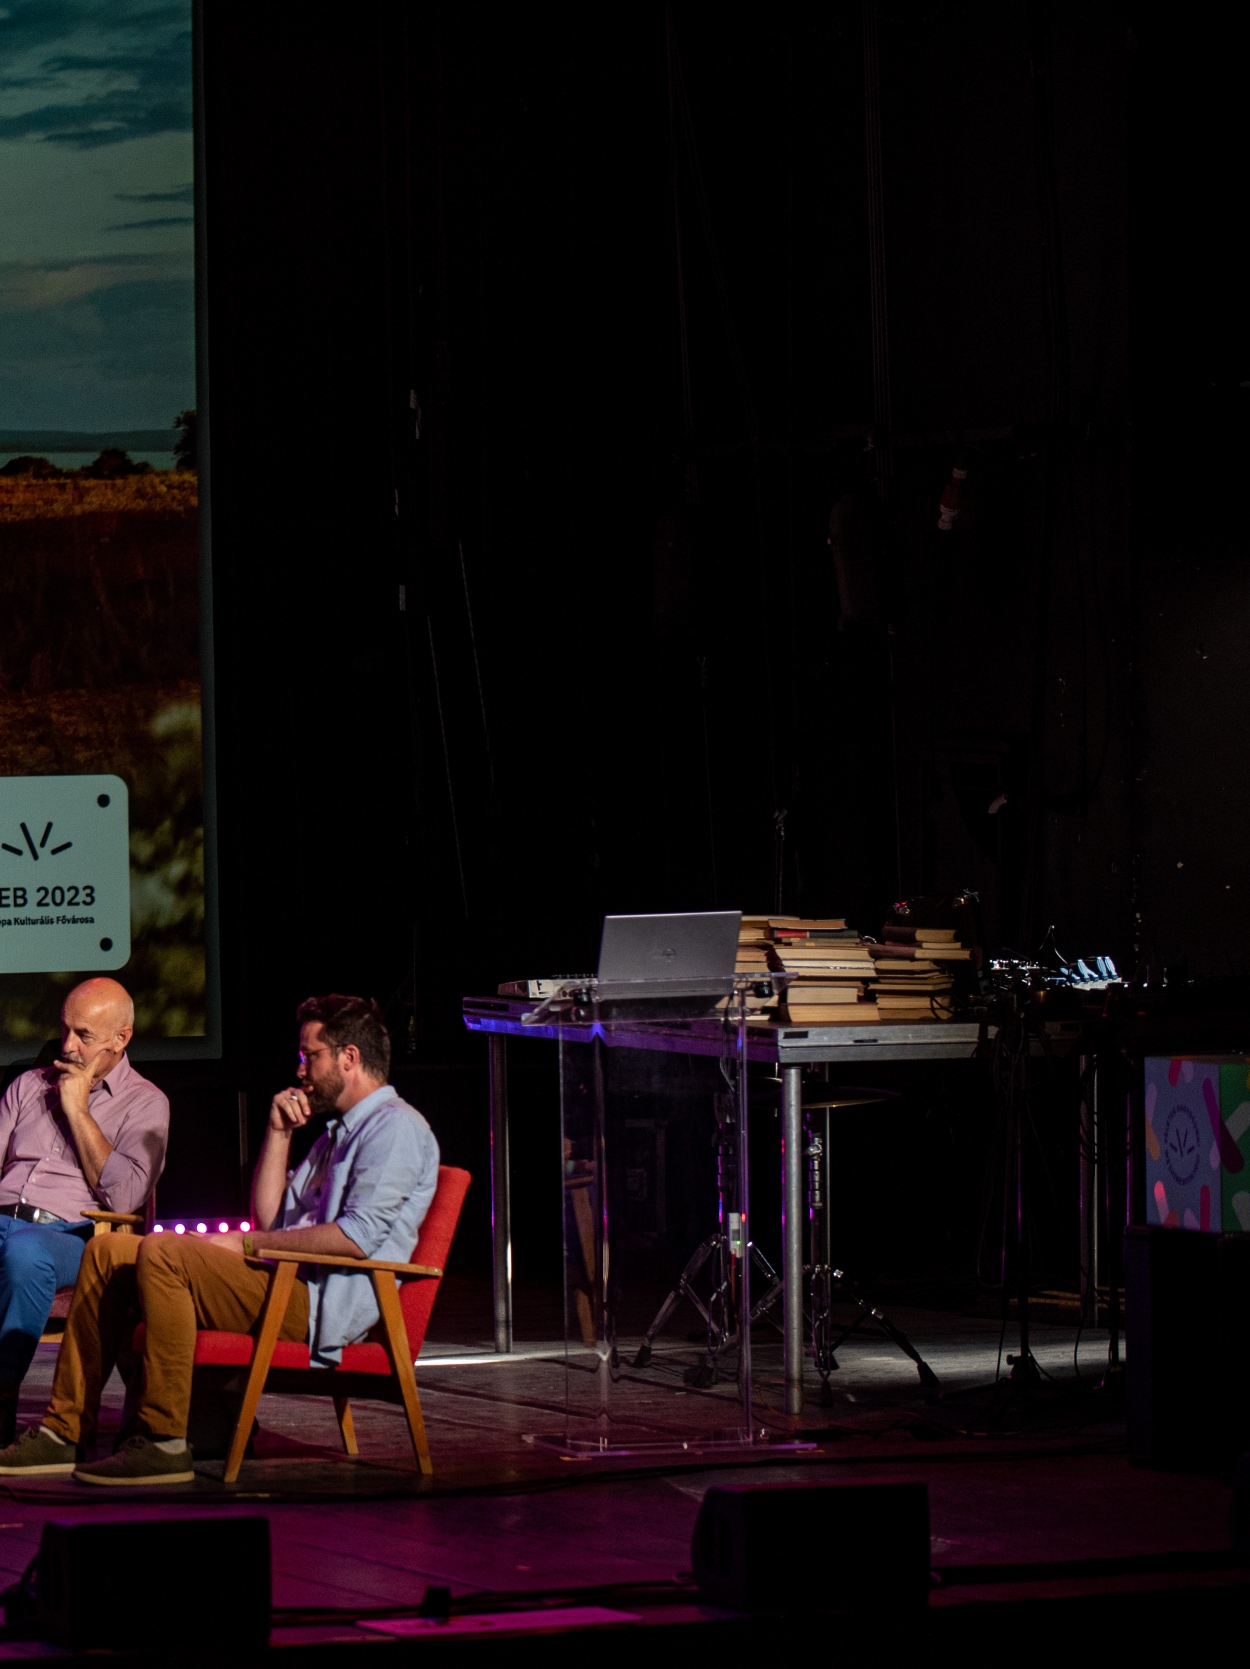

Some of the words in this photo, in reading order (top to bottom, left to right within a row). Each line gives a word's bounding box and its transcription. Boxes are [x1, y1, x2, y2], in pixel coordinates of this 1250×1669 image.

[36, 885, 96, 907] 2023
[14, 915, 55, 926] Kulturális
[56, 915, 95, 925] Fővárosa
